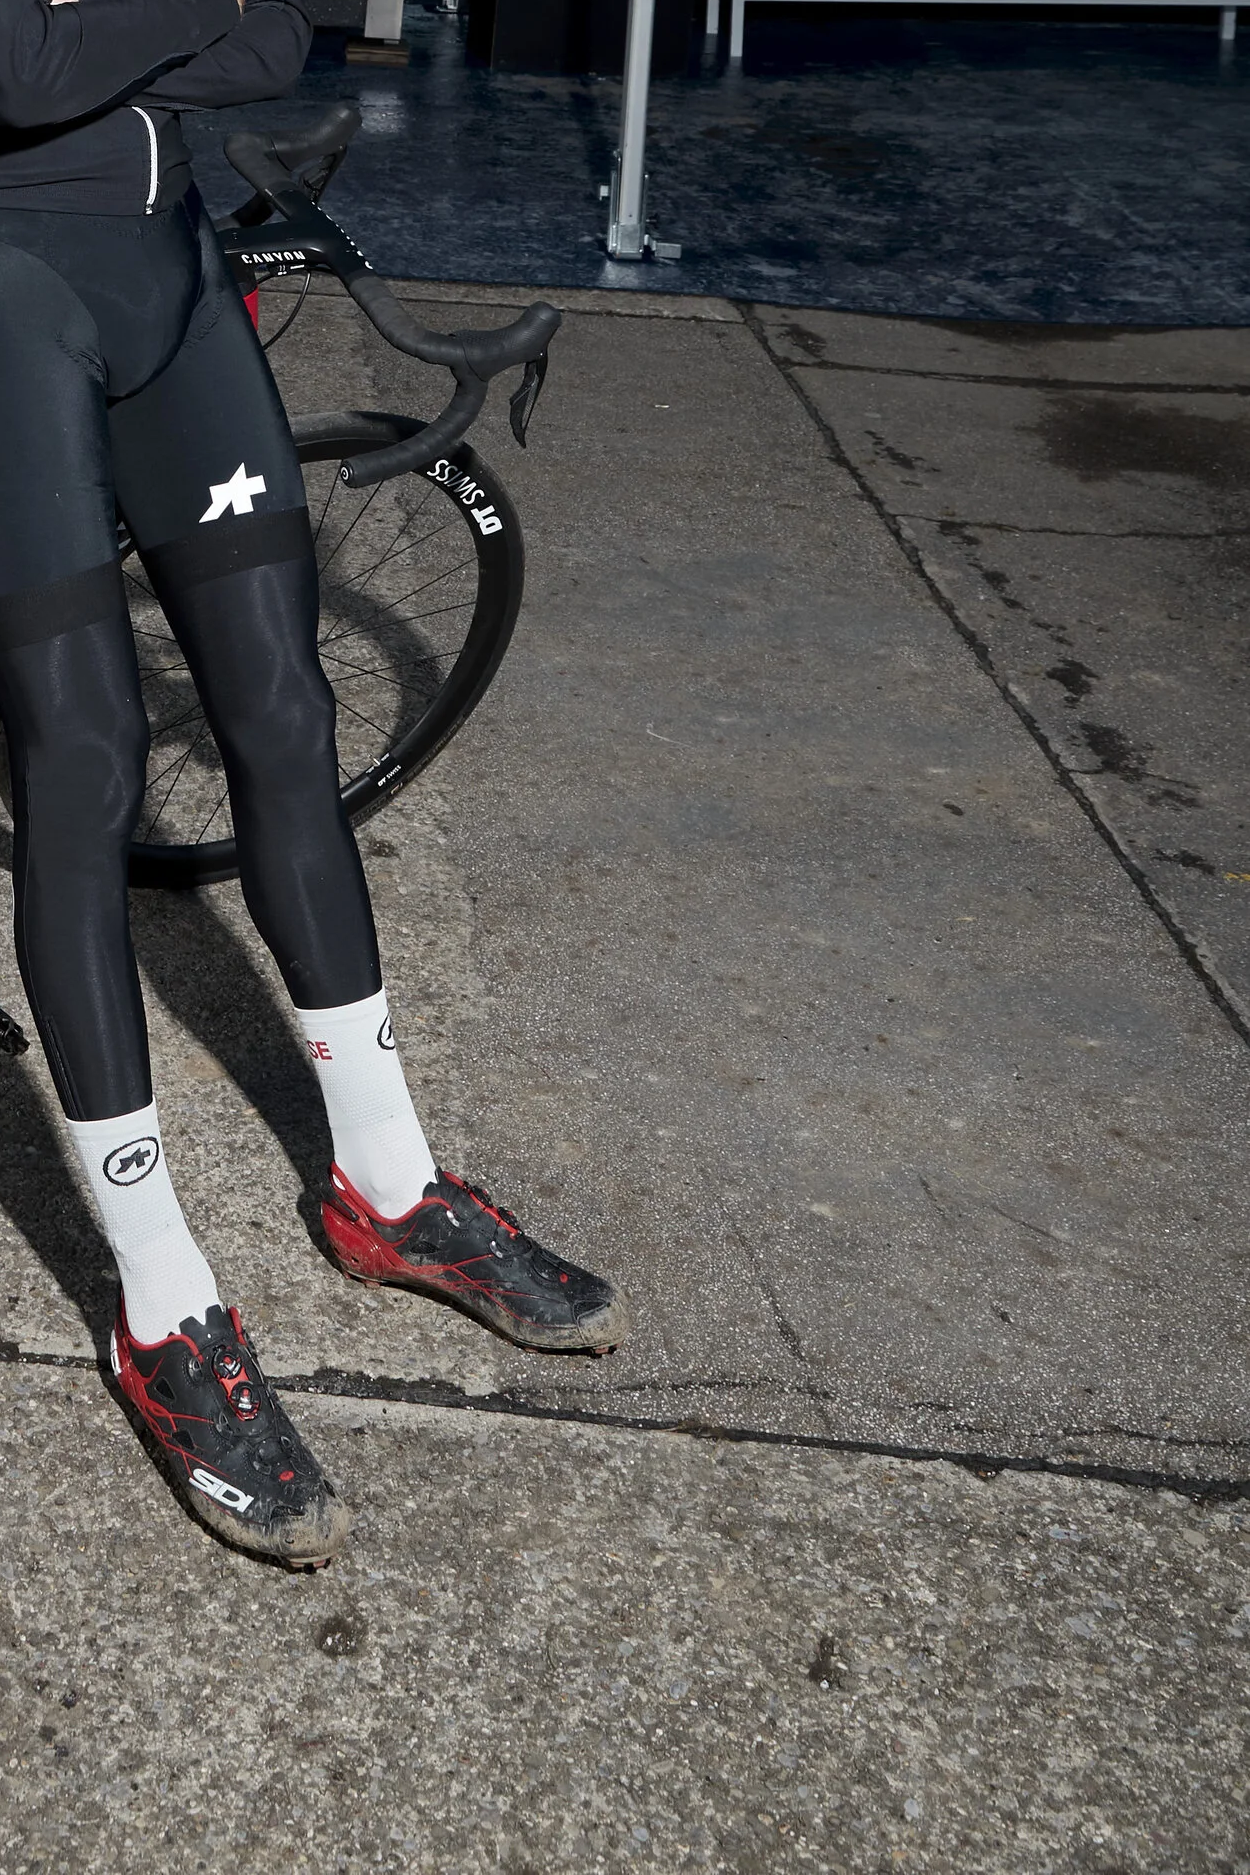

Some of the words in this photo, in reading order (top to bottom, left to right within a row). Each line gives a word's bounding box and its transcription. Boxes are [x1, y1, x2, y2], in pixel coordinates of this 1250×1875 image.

[240, 250, 307, 265] CANYON
[426, 458, 486, 506] SWISS
[469, 505, 503, 536] DT
